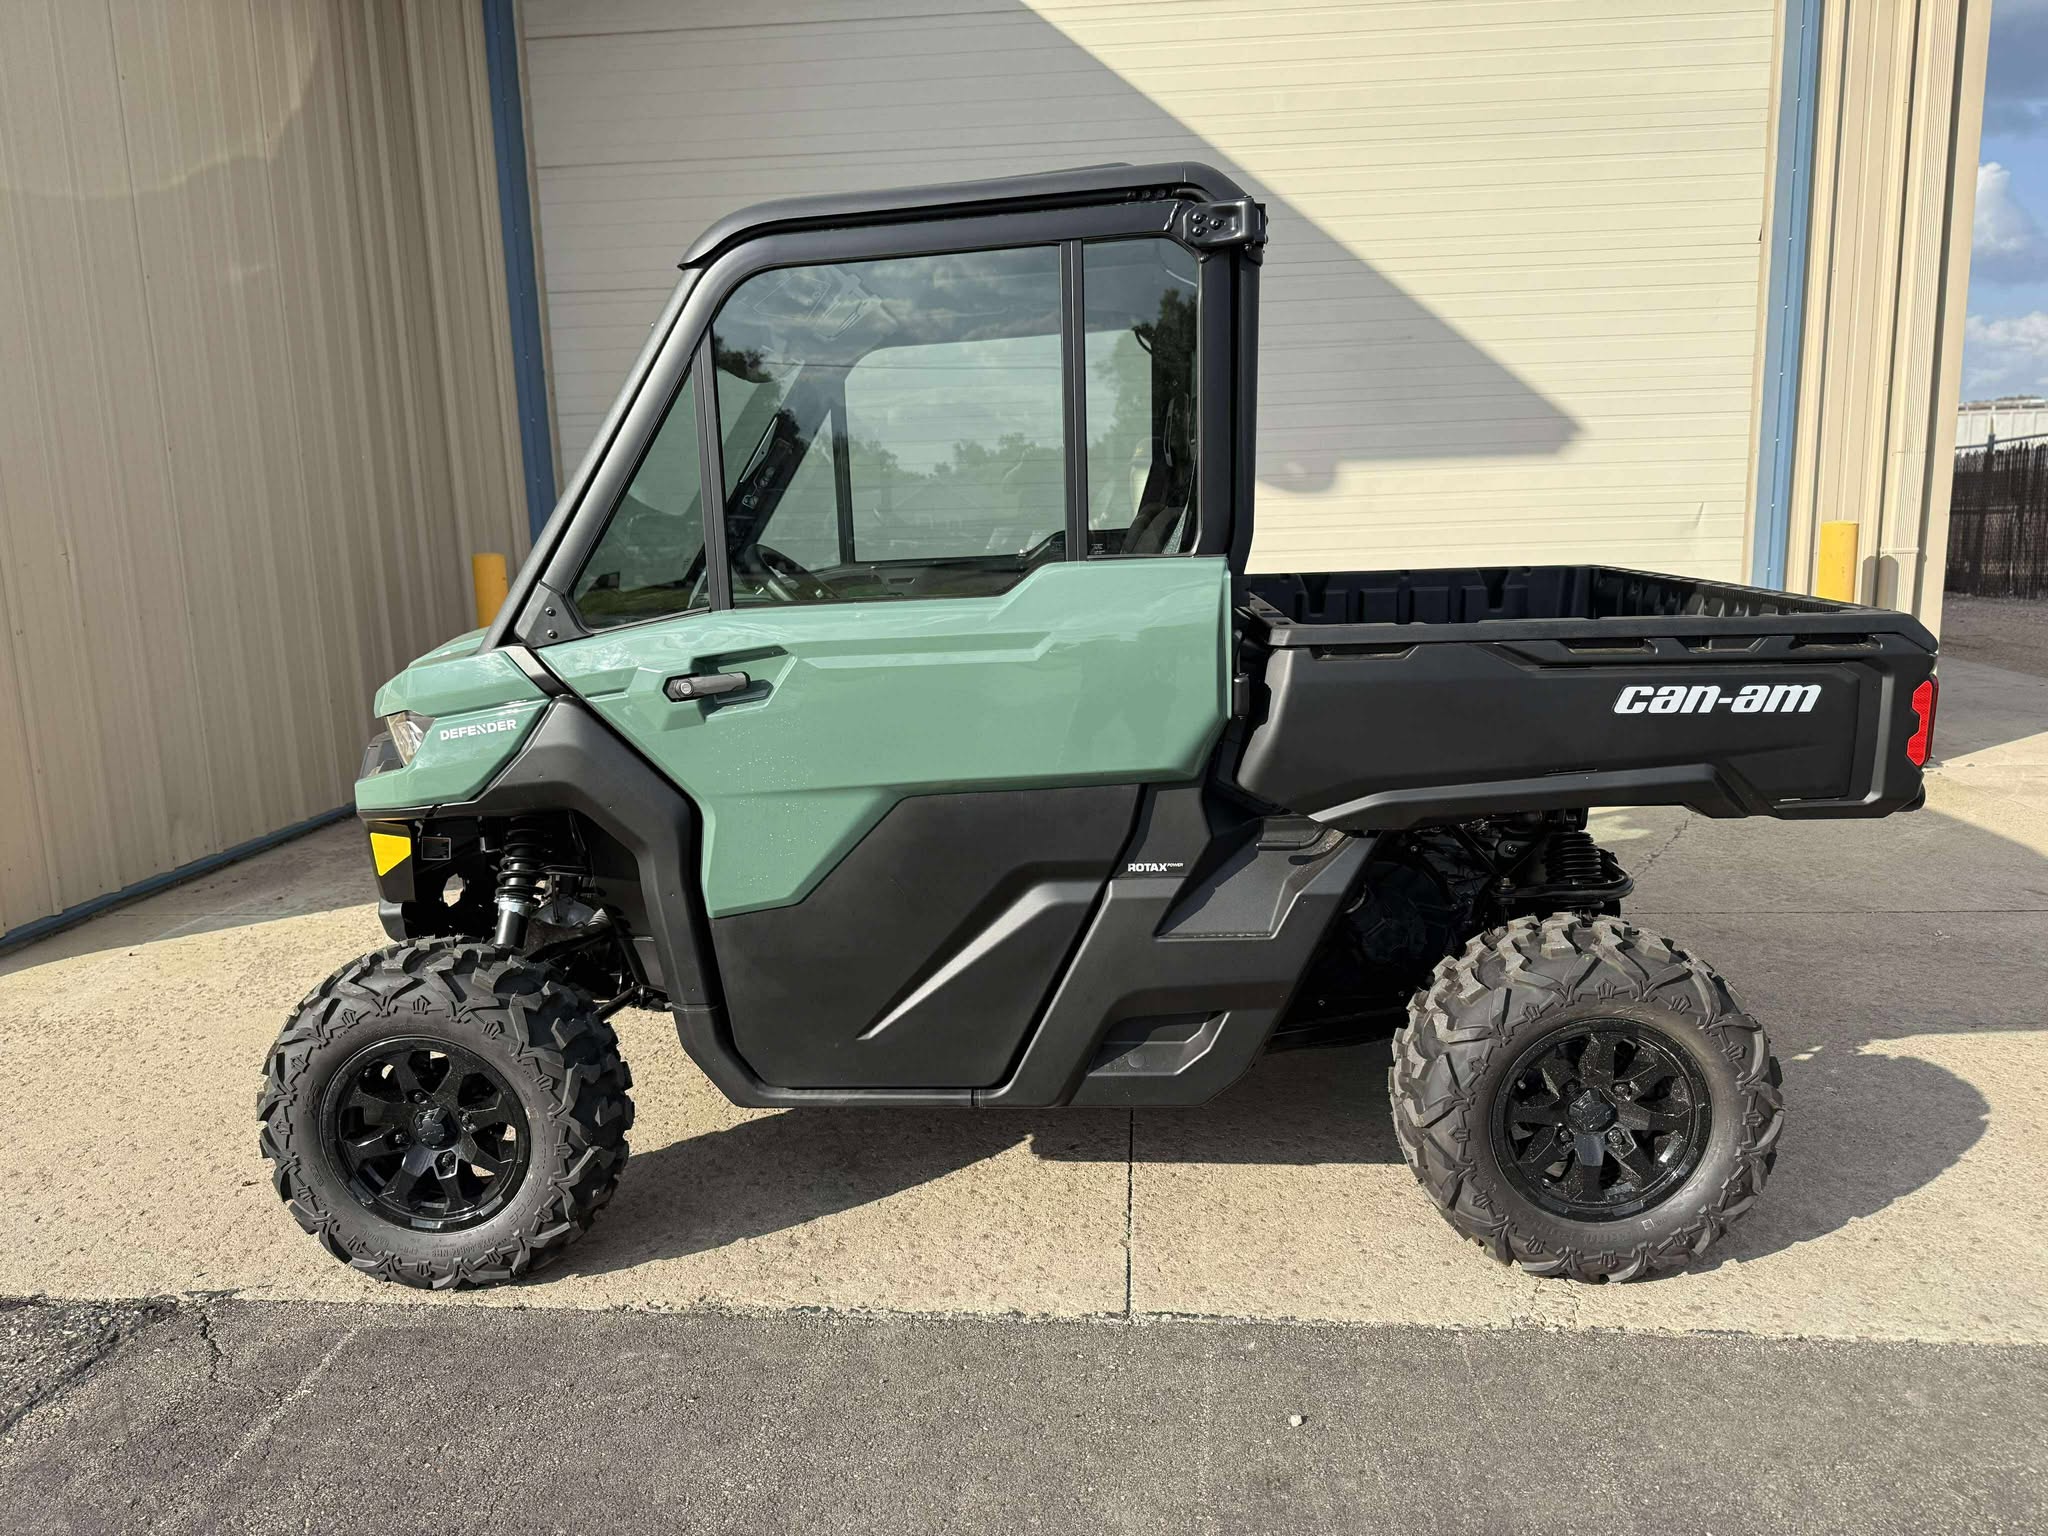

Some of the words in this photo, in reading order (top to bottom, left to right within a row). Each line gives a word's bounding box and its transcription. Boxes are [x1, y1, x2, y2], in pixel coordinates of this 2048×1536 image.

[1614, 685, 1822, 714] can-am
[440, 719, 517, 741] DEFENDER
[1127, 862, 1168, 872] ROTAX
